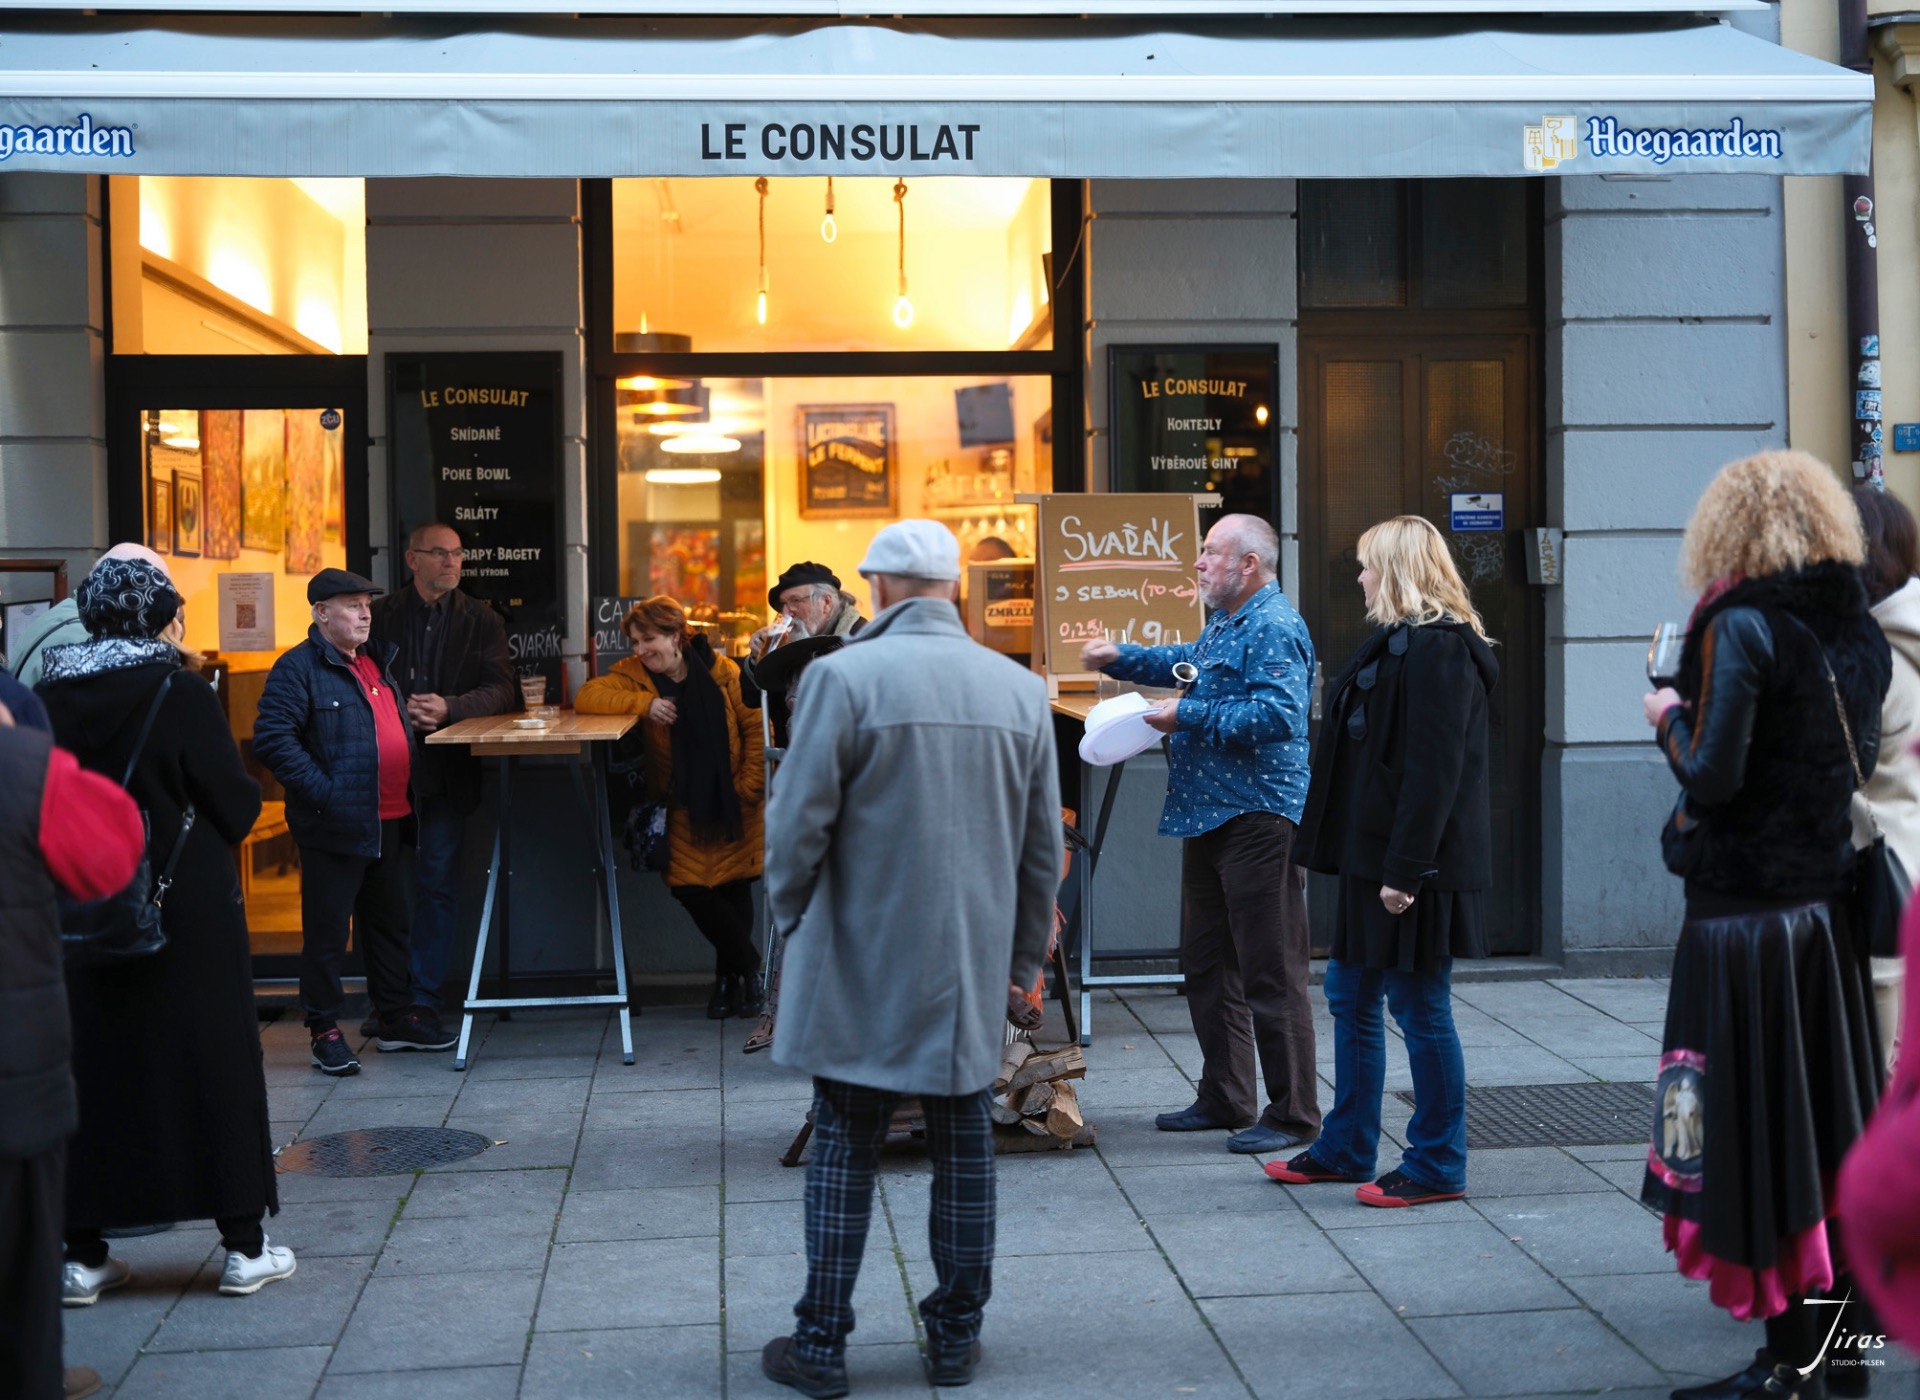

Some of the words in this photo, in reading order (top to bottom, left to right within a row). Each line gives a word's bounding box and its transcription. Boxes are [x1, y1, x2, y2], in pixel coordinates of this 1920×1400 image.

[0, 113, 136, 161] gaarden
[701, 123, 747, 160] LE
[761, 122, 981, 162] CONSULAT
[1585, 115, 1783, 164] Hoegaarden
[444, 386, 530, 407] CONSULAT
[1164, 377, 1248, 398] CONSULAT
[450, 427, 501, 441] SNÍDANĚ
[1151, 455, 1208, 470] VÝBĚROVÉ
[1211, 456, 1239, 470] GINY
[442, 466, 472, 481] POKE
[476, 467, 511, 481] BOWL
[455, 505, 499, 521] SALÁTY
[1060, 515, 1183, 562] SVAŘÁK
[462, 547, 493, 561] RAPY
[497, 546, 541, 561] BAGETY
